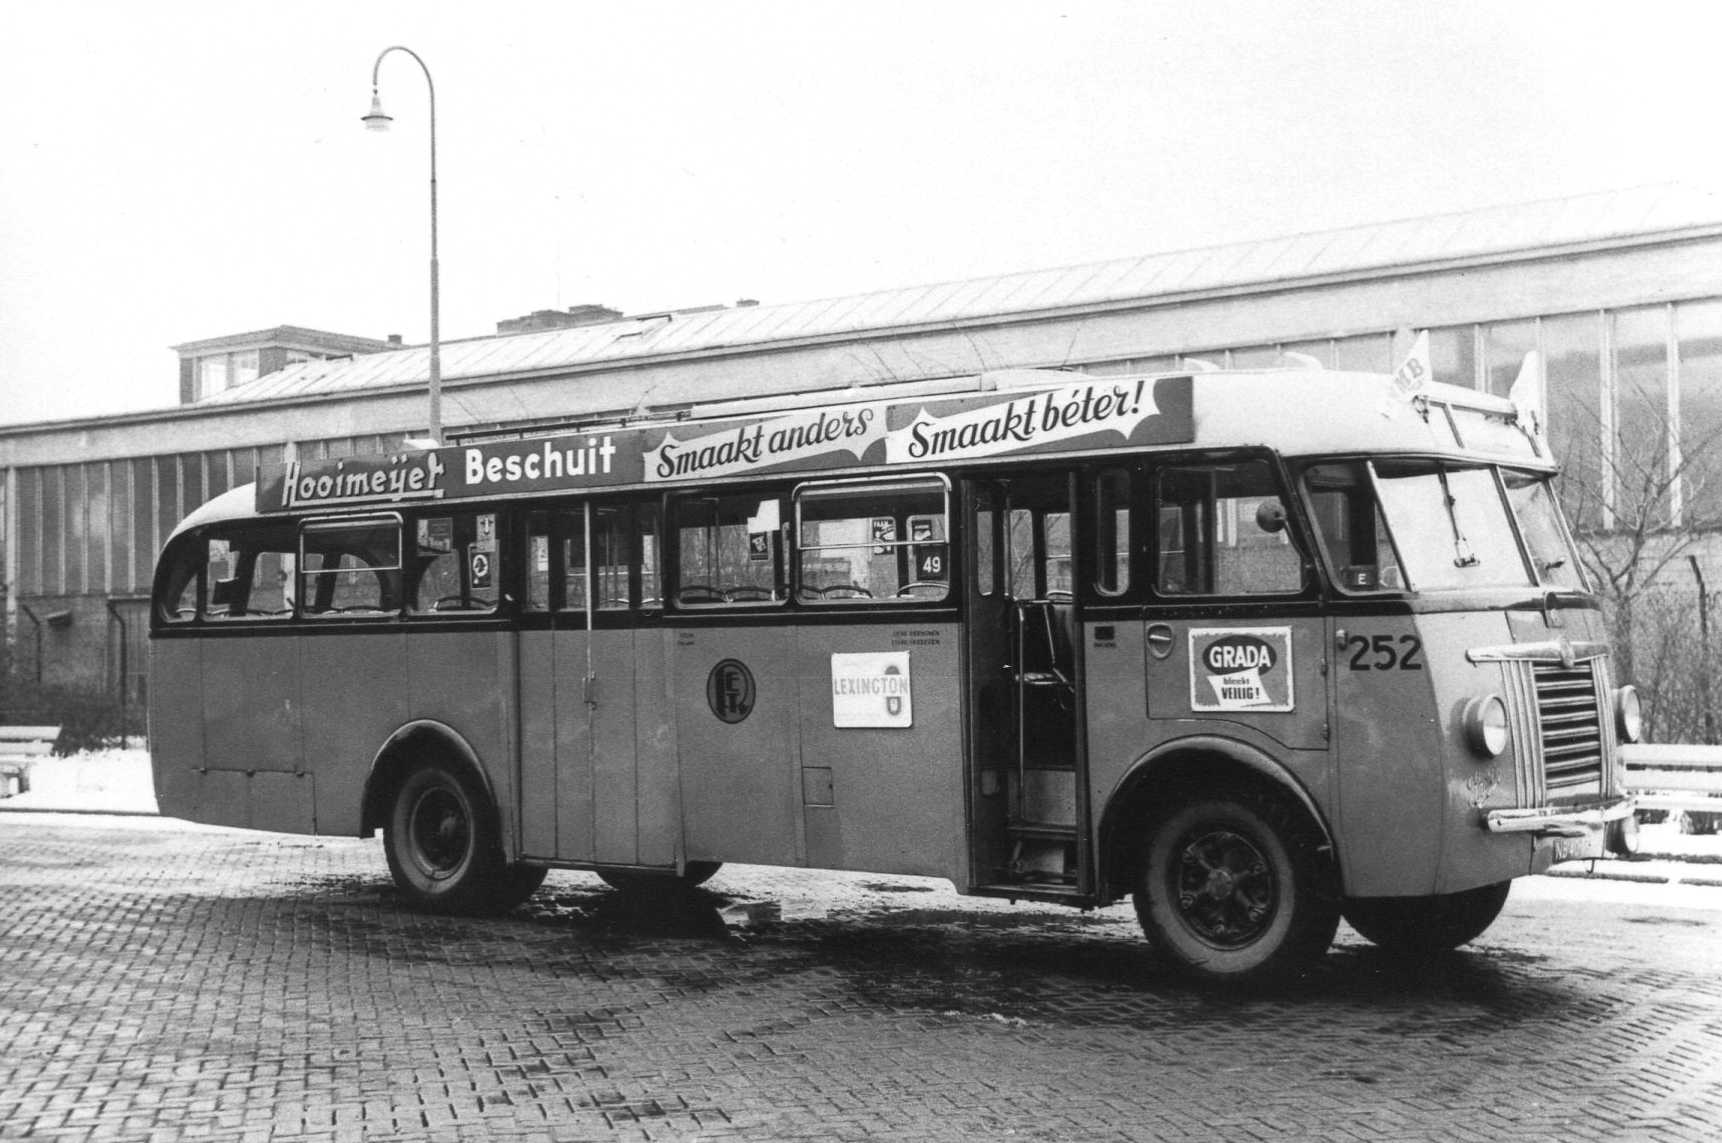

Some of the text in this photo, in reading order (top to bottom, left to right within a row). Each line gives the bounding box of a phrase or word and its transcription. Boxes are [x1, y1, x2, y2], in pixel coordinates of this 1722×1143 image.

[908, 381, 1145, 458] Smaakt béter!
[466, 436, 616, 484] Beschuit
[657, 408, 873, 478] Smaakt anders
[922, 555, 941, 574] 49
[1209, 644, 1272, 669] GRADA
[1349, 635, 1422, 671] 252
[834, 676, 908, 696] LEXINGTON
